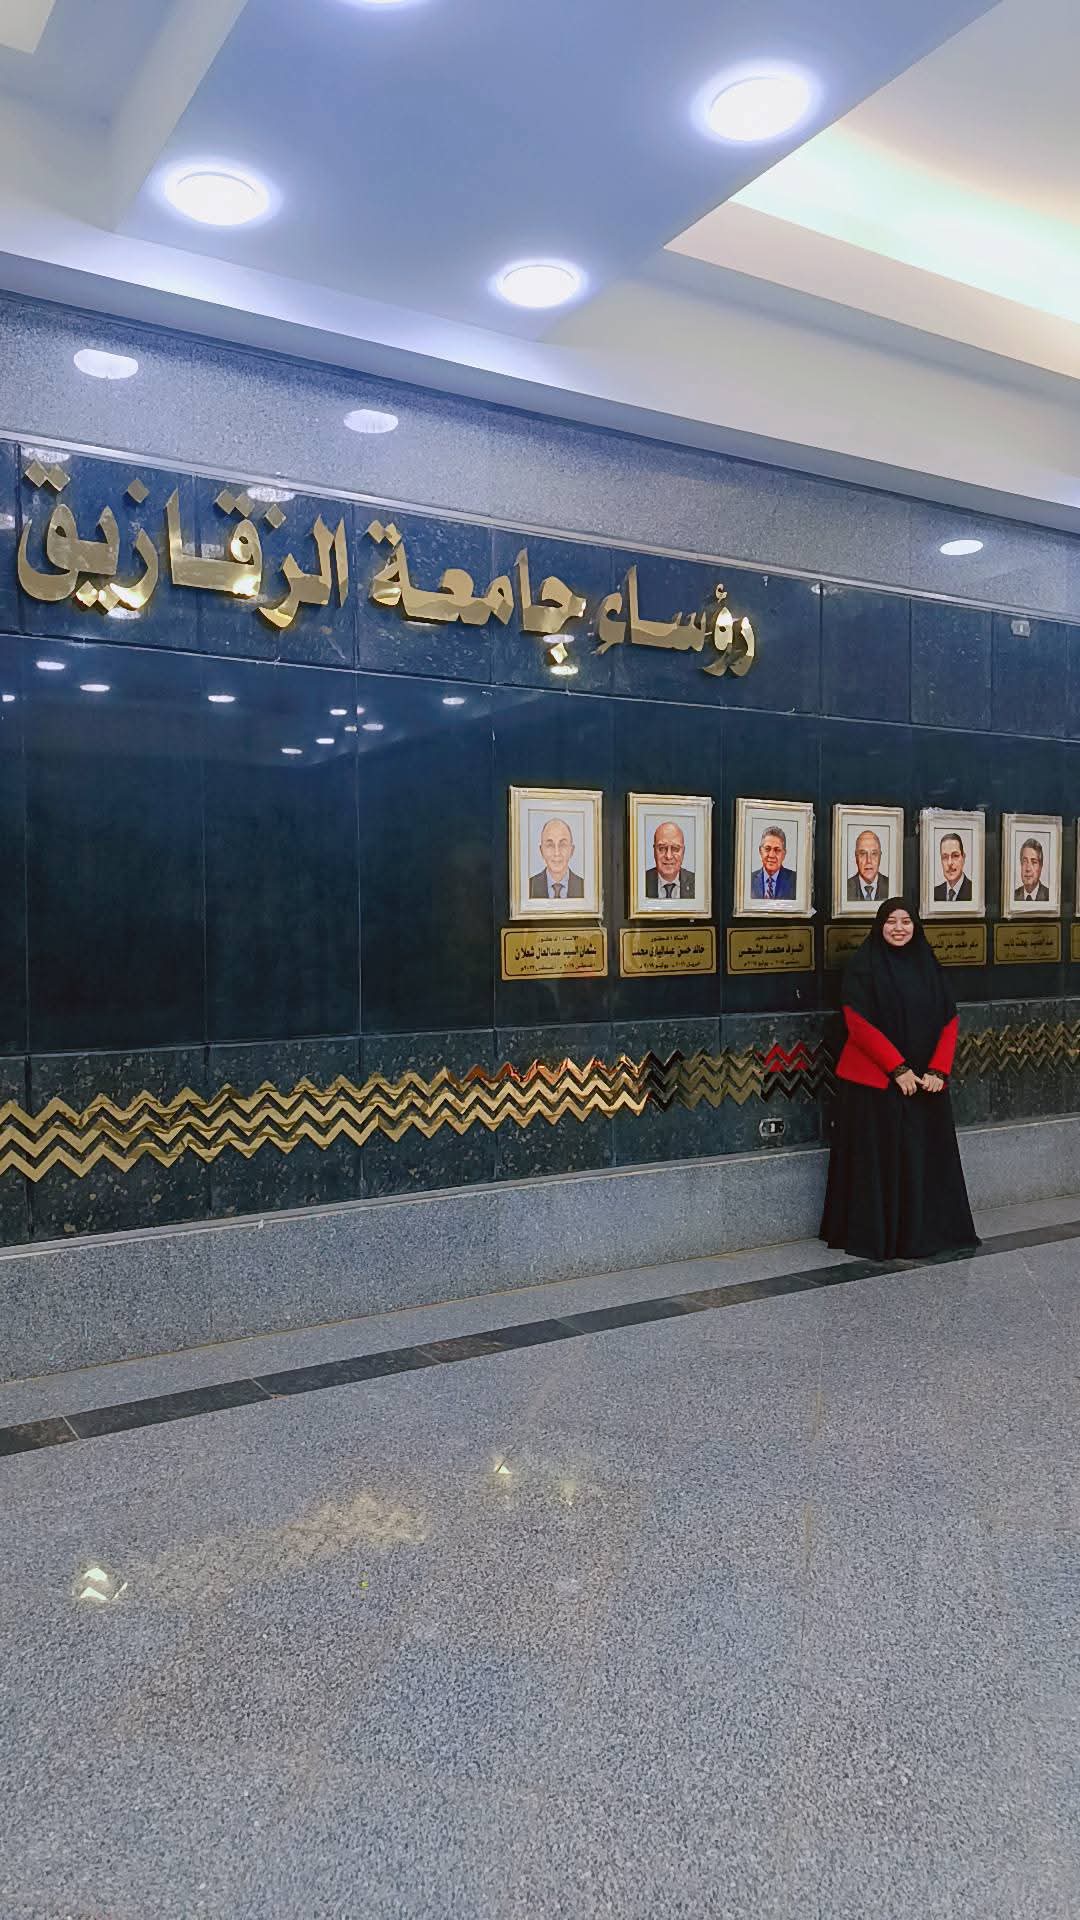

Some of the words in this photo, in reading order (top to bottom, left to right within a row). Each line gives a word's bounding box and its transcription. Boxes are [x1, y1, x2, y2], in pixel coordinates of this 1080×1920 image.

[18, 459, 348, 628] الزقازيق
[367, 520, 587, 664] جامعة
[591, 564, 755, 677] رؤساء
